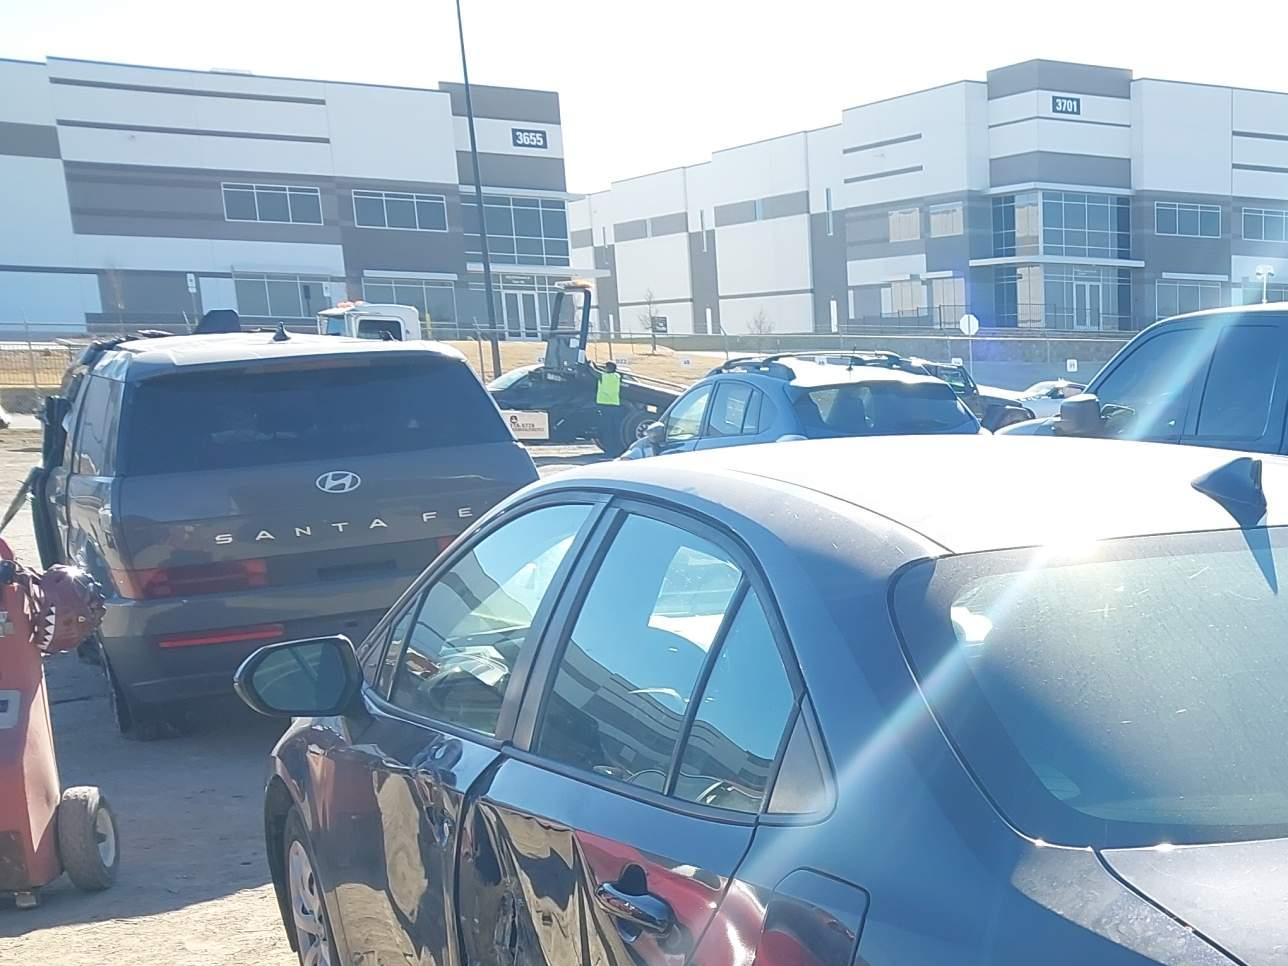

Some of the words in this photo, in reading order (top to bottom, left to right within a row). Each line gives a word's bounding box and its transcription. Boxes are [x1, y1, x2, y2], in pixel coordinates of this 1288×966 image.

[1055, 98, 1078, 113] 3701
[515, 131, 544, 146] 3655
[215, 518, 388, 545] SANTA
[422, 507, 474, 523] FE
